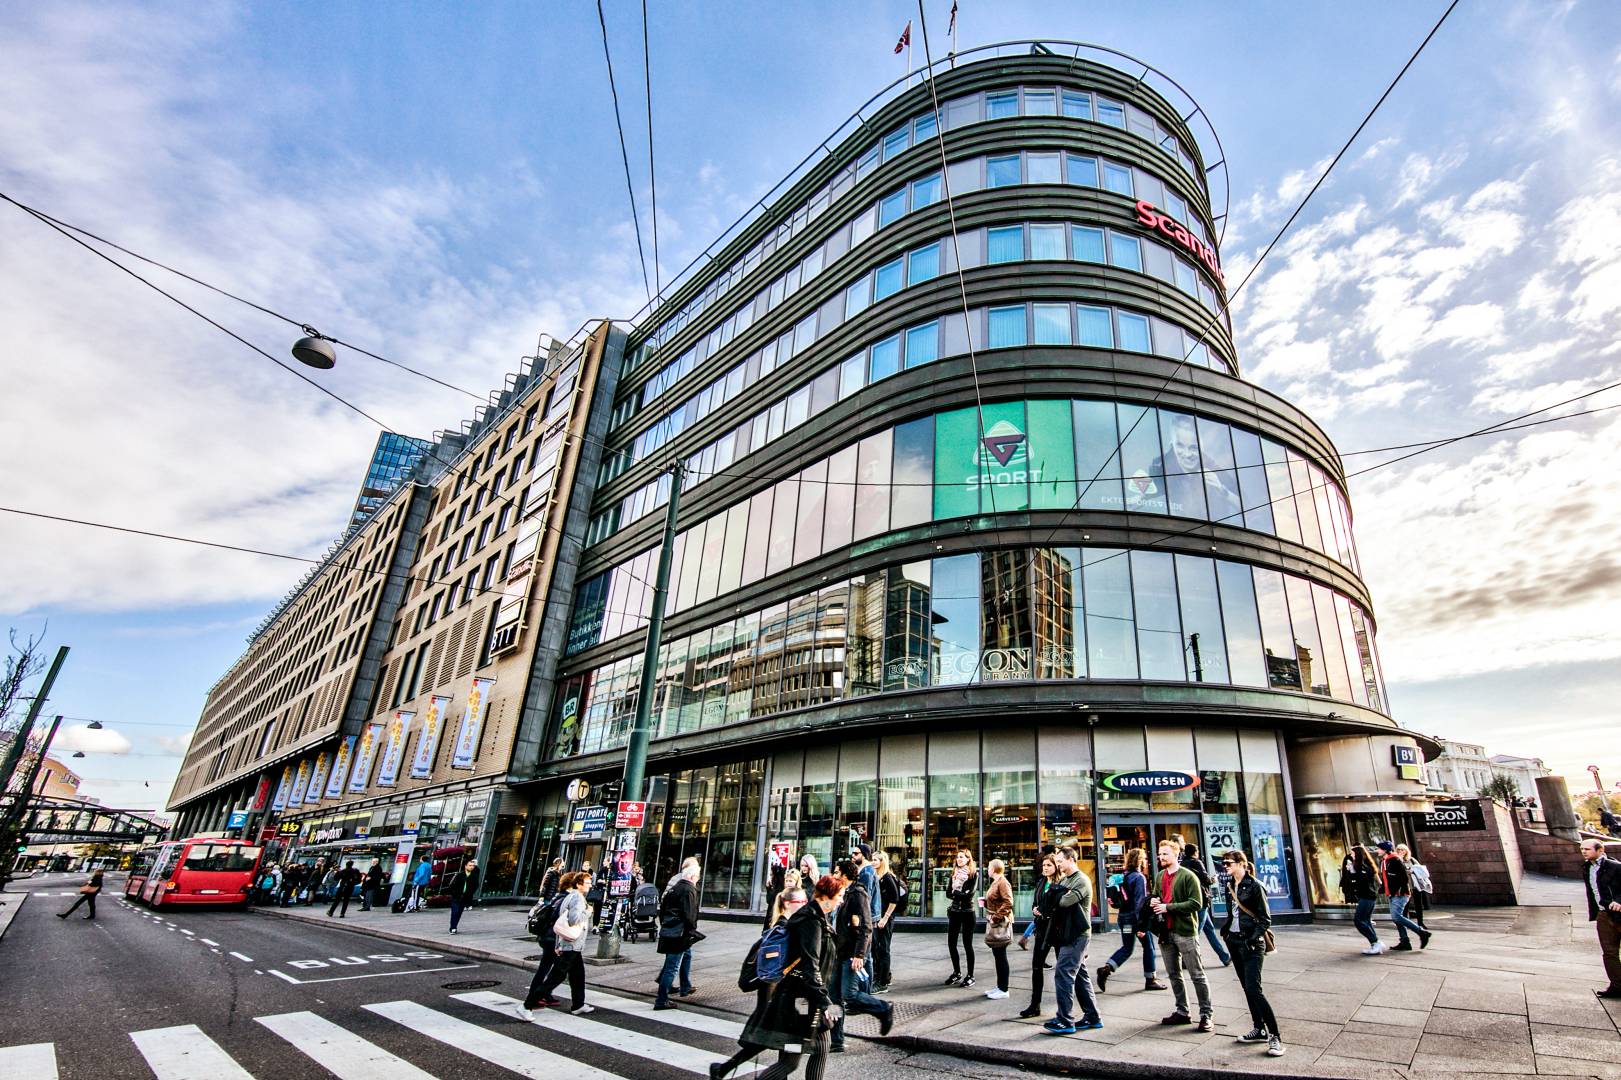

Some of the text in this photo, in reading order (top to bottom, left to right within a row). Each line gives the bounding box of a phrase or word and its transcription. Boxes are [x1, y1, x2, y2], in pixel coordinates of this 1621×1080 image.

[966, 469, 1042, 491] SPORT
[934, 648, 1030, 676] EGON
[1401, 749, 1413, 761] BY
[1120, 776, 1185, 787] NARVESEN
[580, 784, 588, 797] T
[576, 810, 585, 819] BY
[1425, 810, 1467, 821] EGON
[1260, 864, 1280, 874] 2 FOR
[286, 951, 444, 969] BUSS
